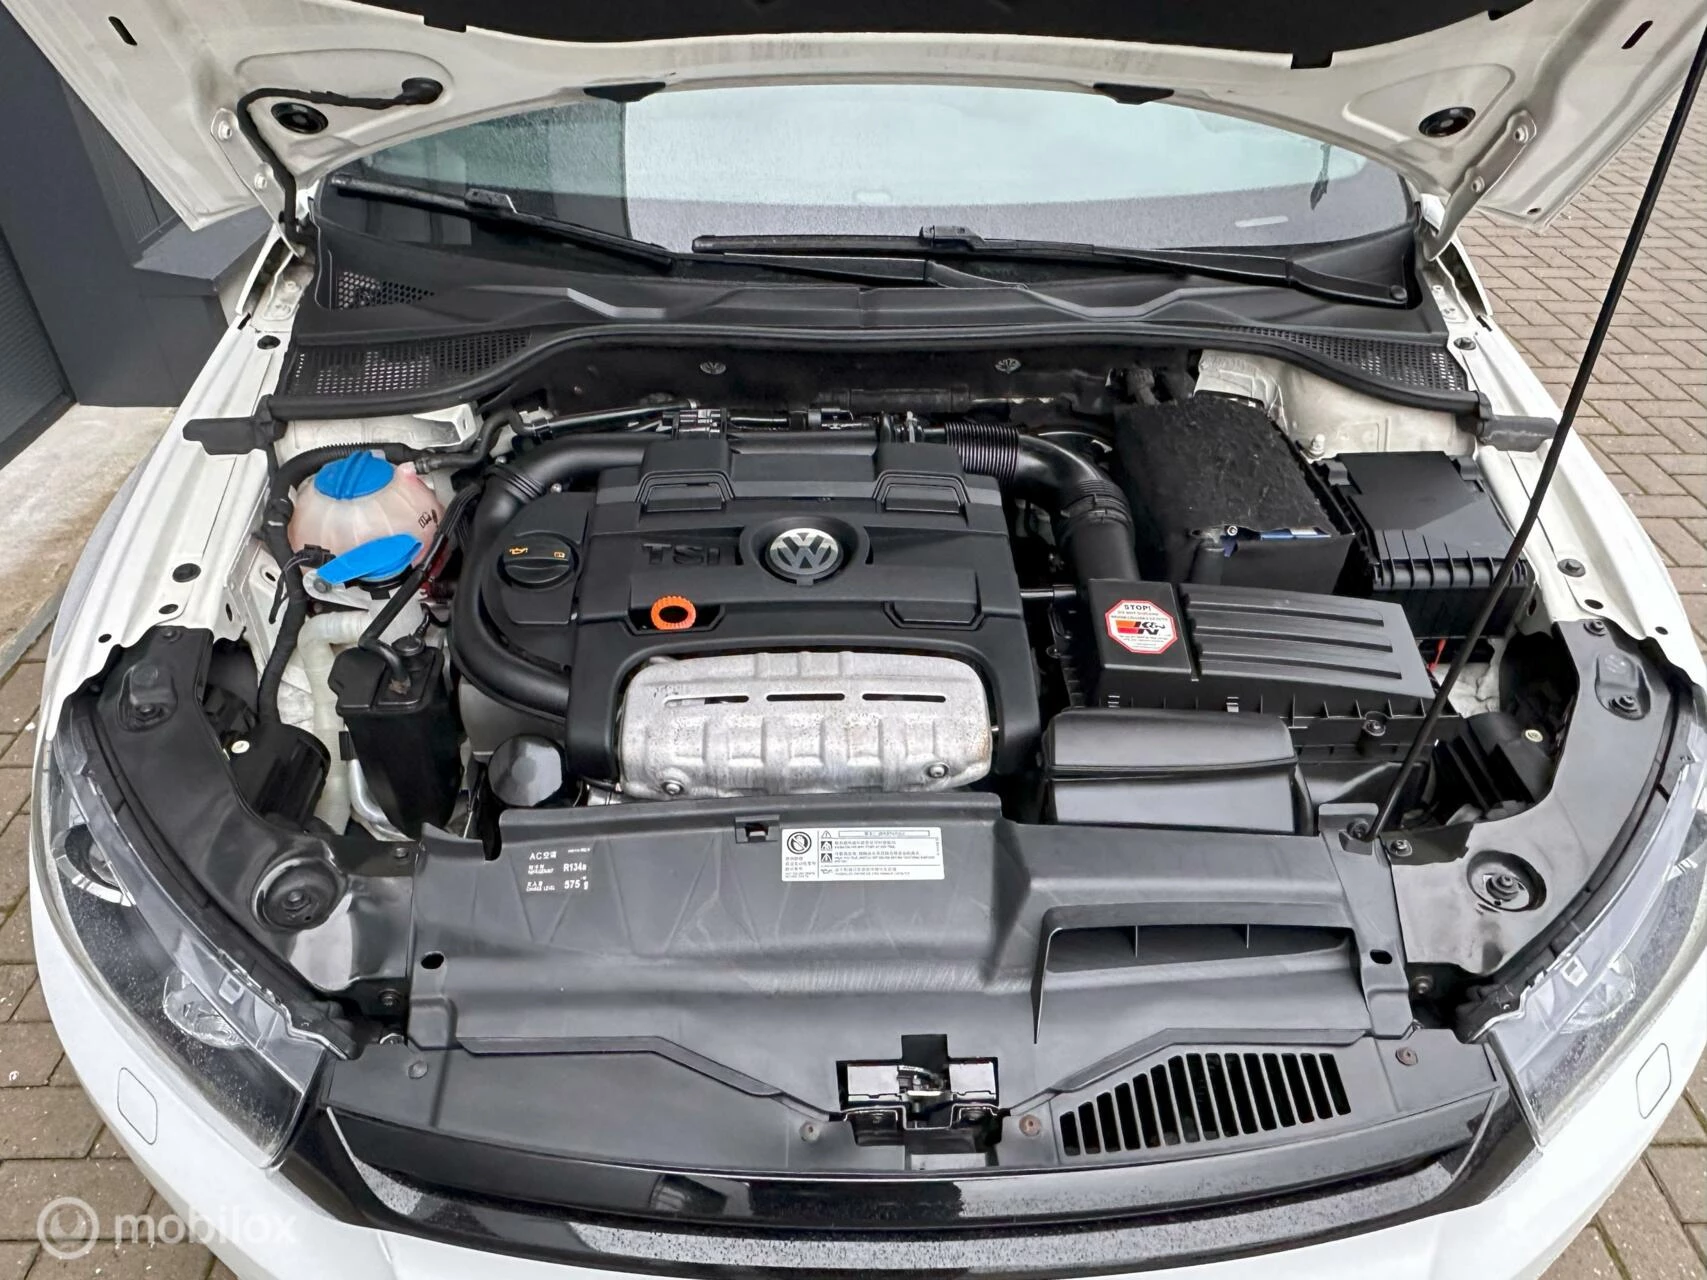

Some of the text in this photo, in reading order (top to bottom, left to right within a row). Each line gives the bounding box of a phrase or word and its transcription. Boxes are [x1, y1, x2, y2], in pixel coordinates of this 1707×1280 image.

[642, 543, 720, 565] TSI
[770, 528, 838, 574] VW
[563, 862, 587, 872] R134a
